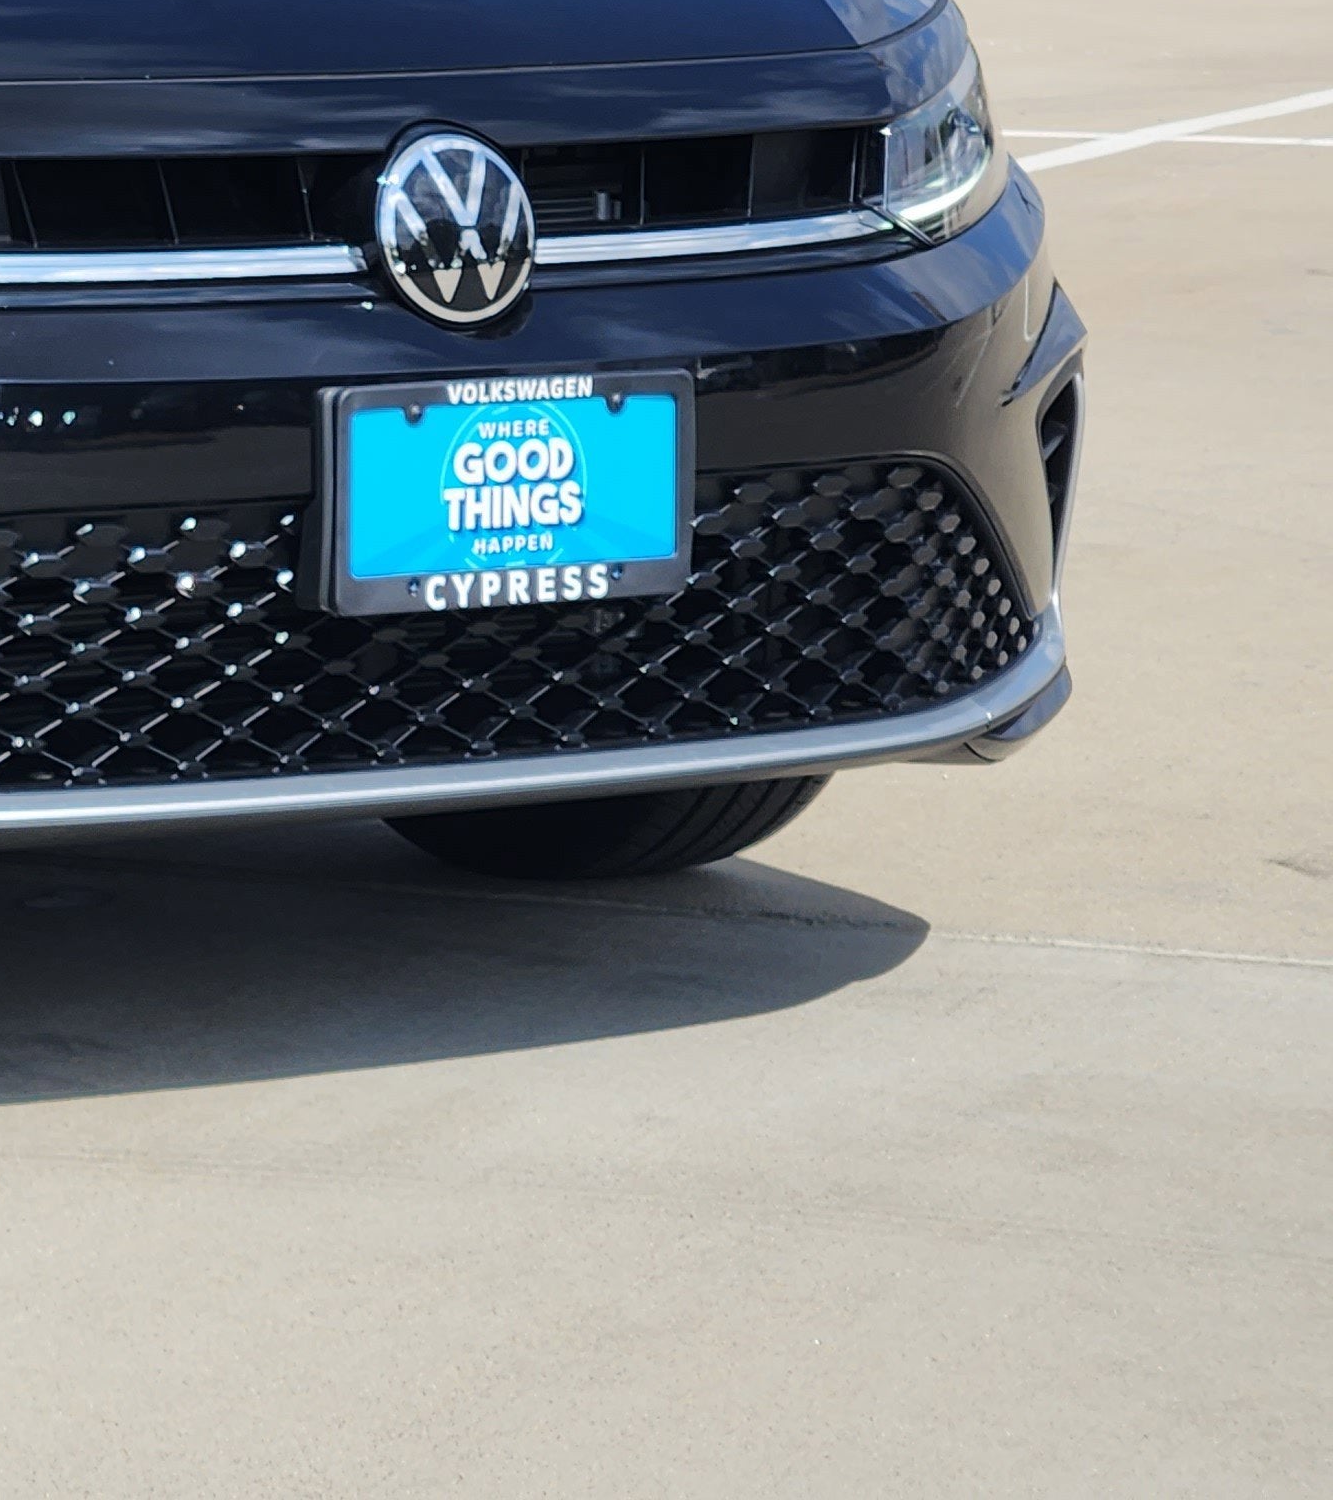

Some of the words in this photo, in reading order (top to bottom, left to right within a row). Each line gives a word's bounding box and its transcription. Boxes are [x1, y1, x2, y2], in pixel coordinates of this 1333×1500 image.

[379, 135, 534, 321] VW
[446, 374, 594, 405] VOLKSWAGEN
[478, 418, 550, 440] WHERE
[453, 437, 575, 486] GOOD
[443, 480, 584, 532] THINGS
[473, 532, 554, 556] HAPPEN
[425, 563, 609, 612] CYPRESS
